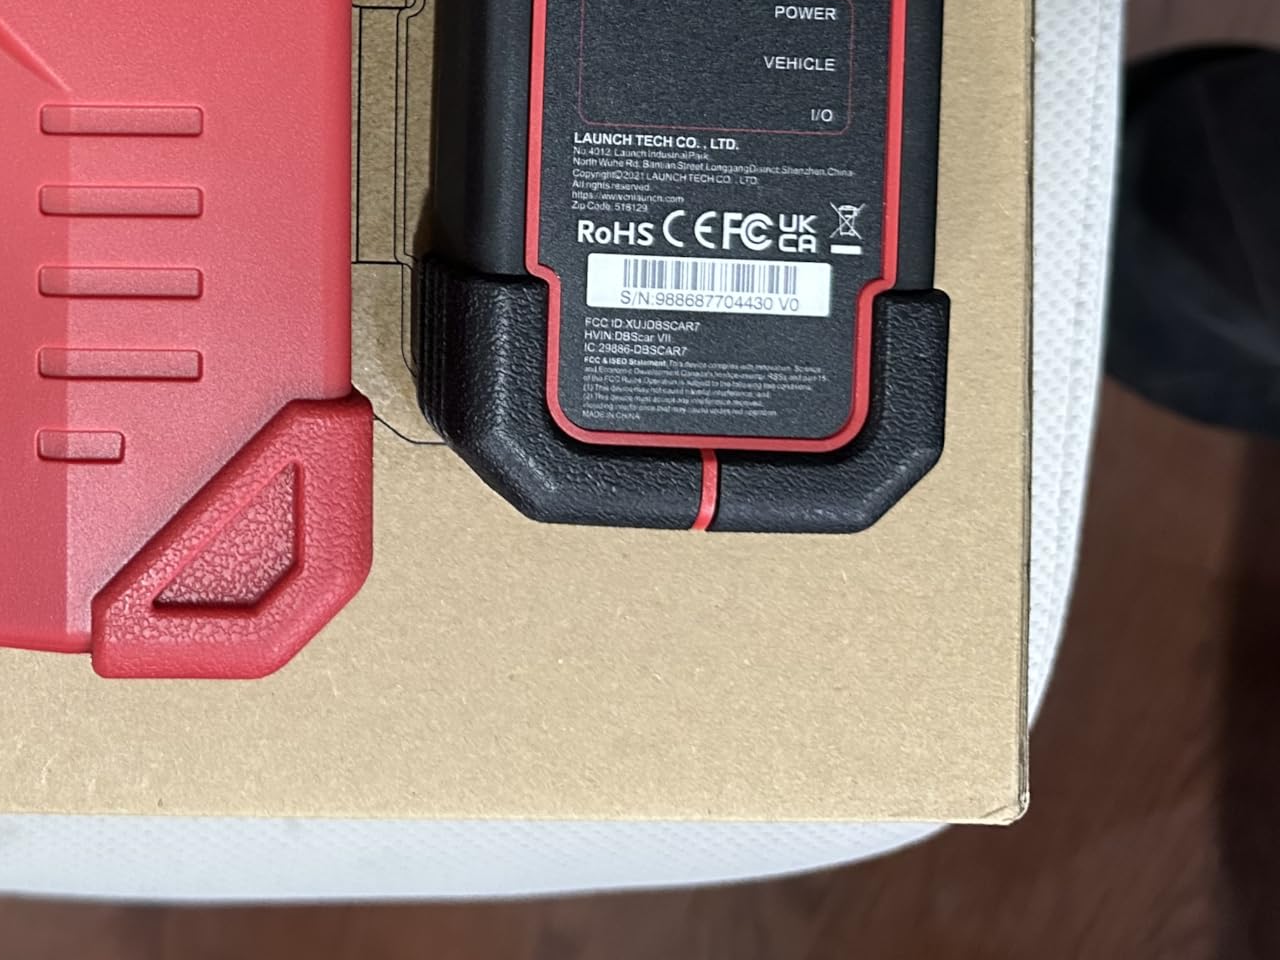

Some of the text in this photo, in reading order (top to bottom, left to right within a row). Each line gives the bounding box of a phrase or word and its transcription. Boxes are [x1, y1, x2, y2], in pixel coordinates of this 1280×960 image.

[774, 5, 837, 20] POWER
[763, 55, 837, 72] VEHICLE
[811, 108, 833, 122] I/O
[574, 132, 632, 146] LAUNCH
[635, 134, 672, 147] TECH
[710, 138, 740, 150] LTD.
[646, 172, 687, 181] LAUNCH
[577, 219, 654, 246] RoHS
[778, 297, 799, 312] V0
[585, 317, 609, 327] FCC
